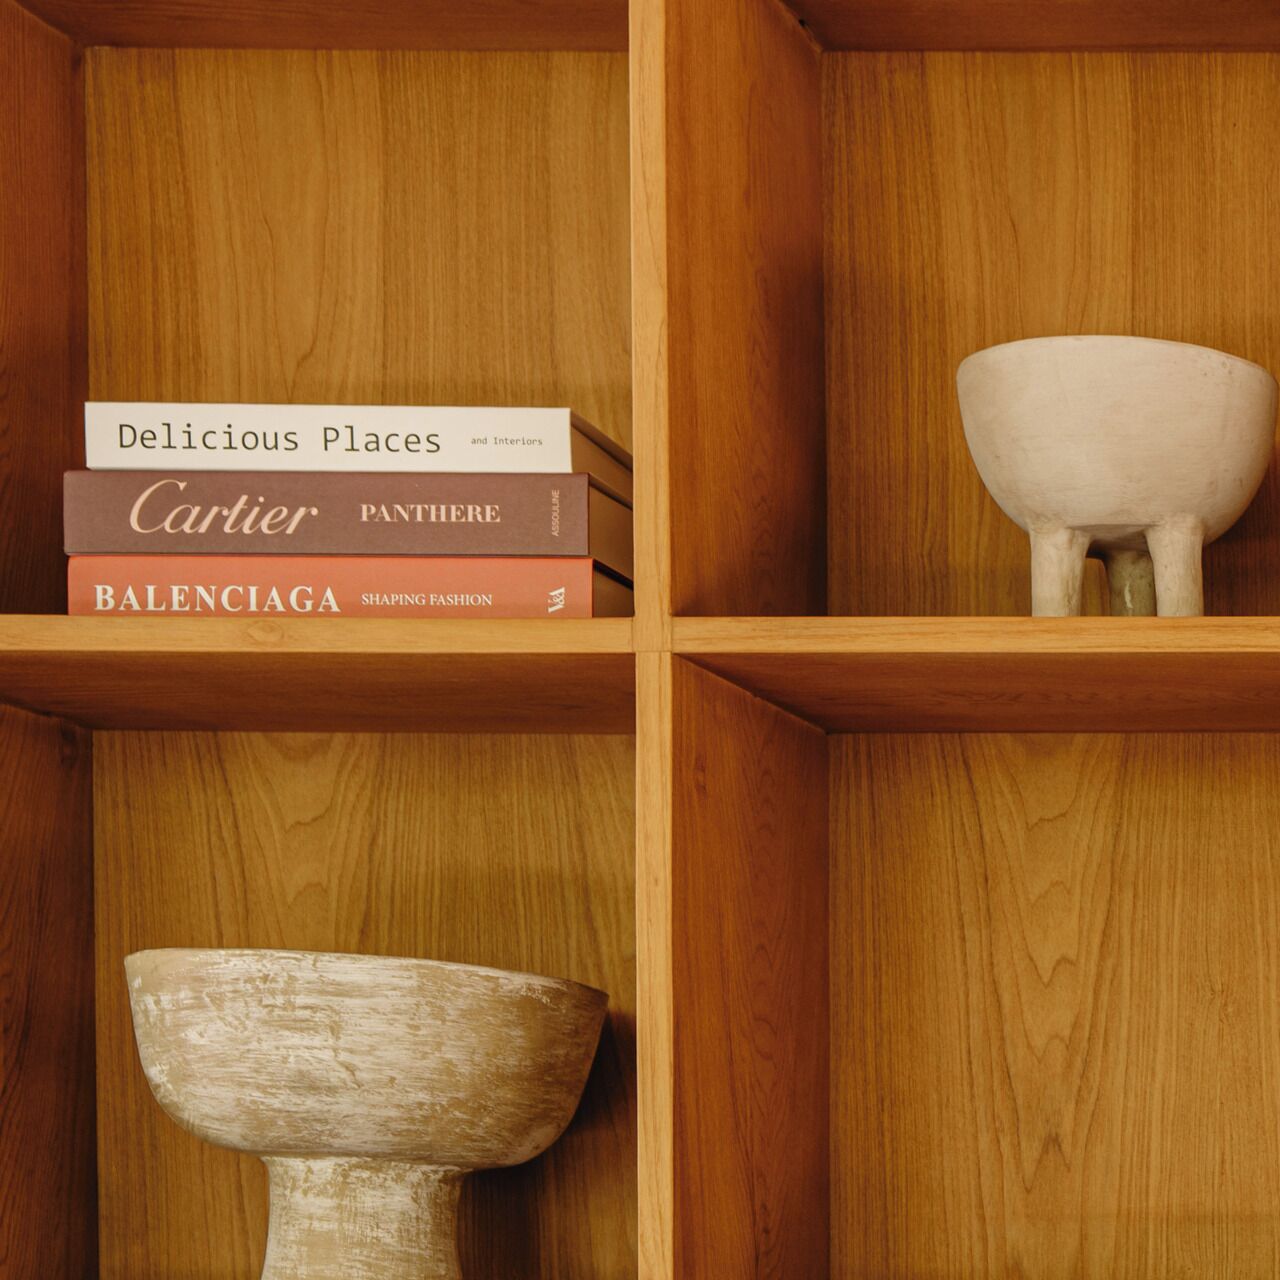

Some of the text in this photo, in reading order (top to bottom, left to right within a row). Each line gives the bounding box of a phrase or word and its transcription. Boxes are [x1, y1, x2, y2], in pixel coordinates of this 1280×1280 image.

[118, 422, 441, 453] Delicious Places
[471, 436, 543, 447] and Interiors
[129, 479, 319, 535] Cartier
[359, 503, 501, 523] PANTHERE
[551, 489, 560, 537] ASSOULINE
[93, 585, 341, 613] BALENCIAGA
[361, 593, 493, 607] SHAPING FASHION
